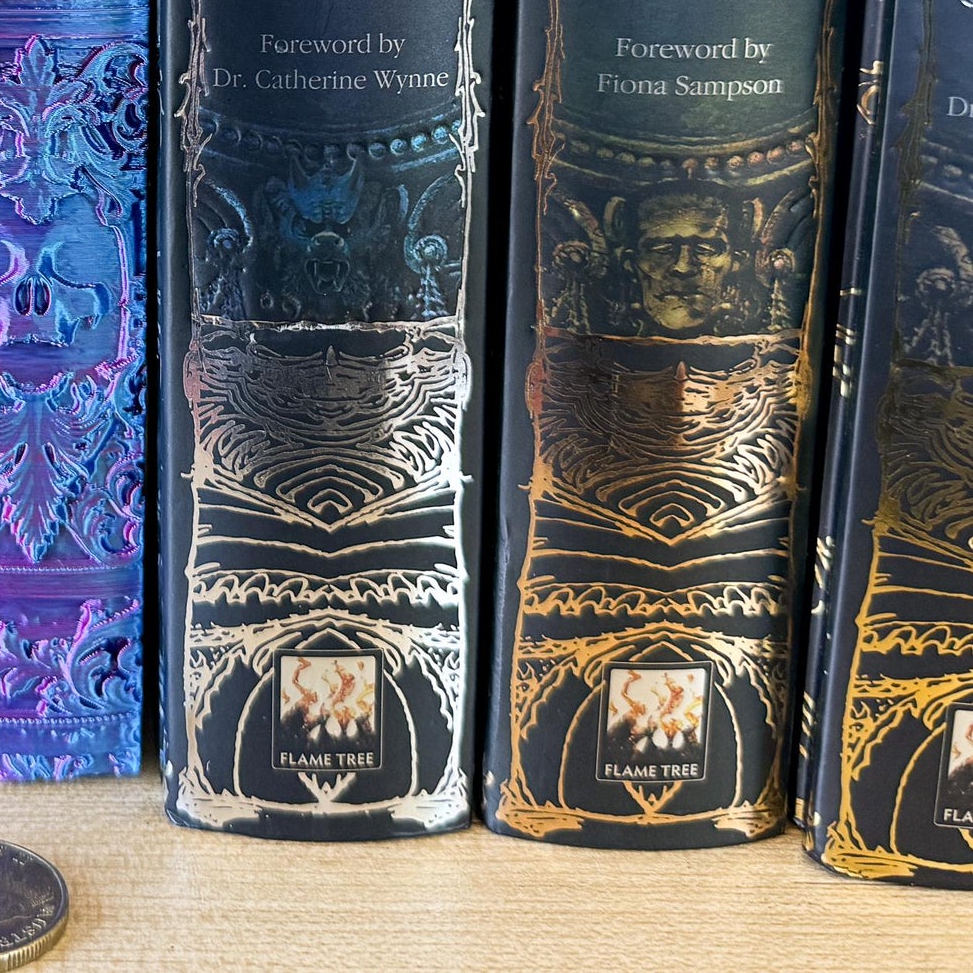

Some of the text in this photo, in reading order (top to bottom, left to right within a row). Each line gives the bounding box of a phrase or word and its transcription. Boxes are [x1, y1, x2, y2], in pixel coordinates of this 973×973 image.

[259, 33, 406, 58] Foreword by
[614, 37, 775, 64] Foreword by
[212, 68, 449, 94] Dr. Catherine Wynne
[596, 73, 784, 101] Fiona Sampson
[280, 752, 374, 766] FLAME TREE
[604, 763, 699, 777] FLAME TREE
